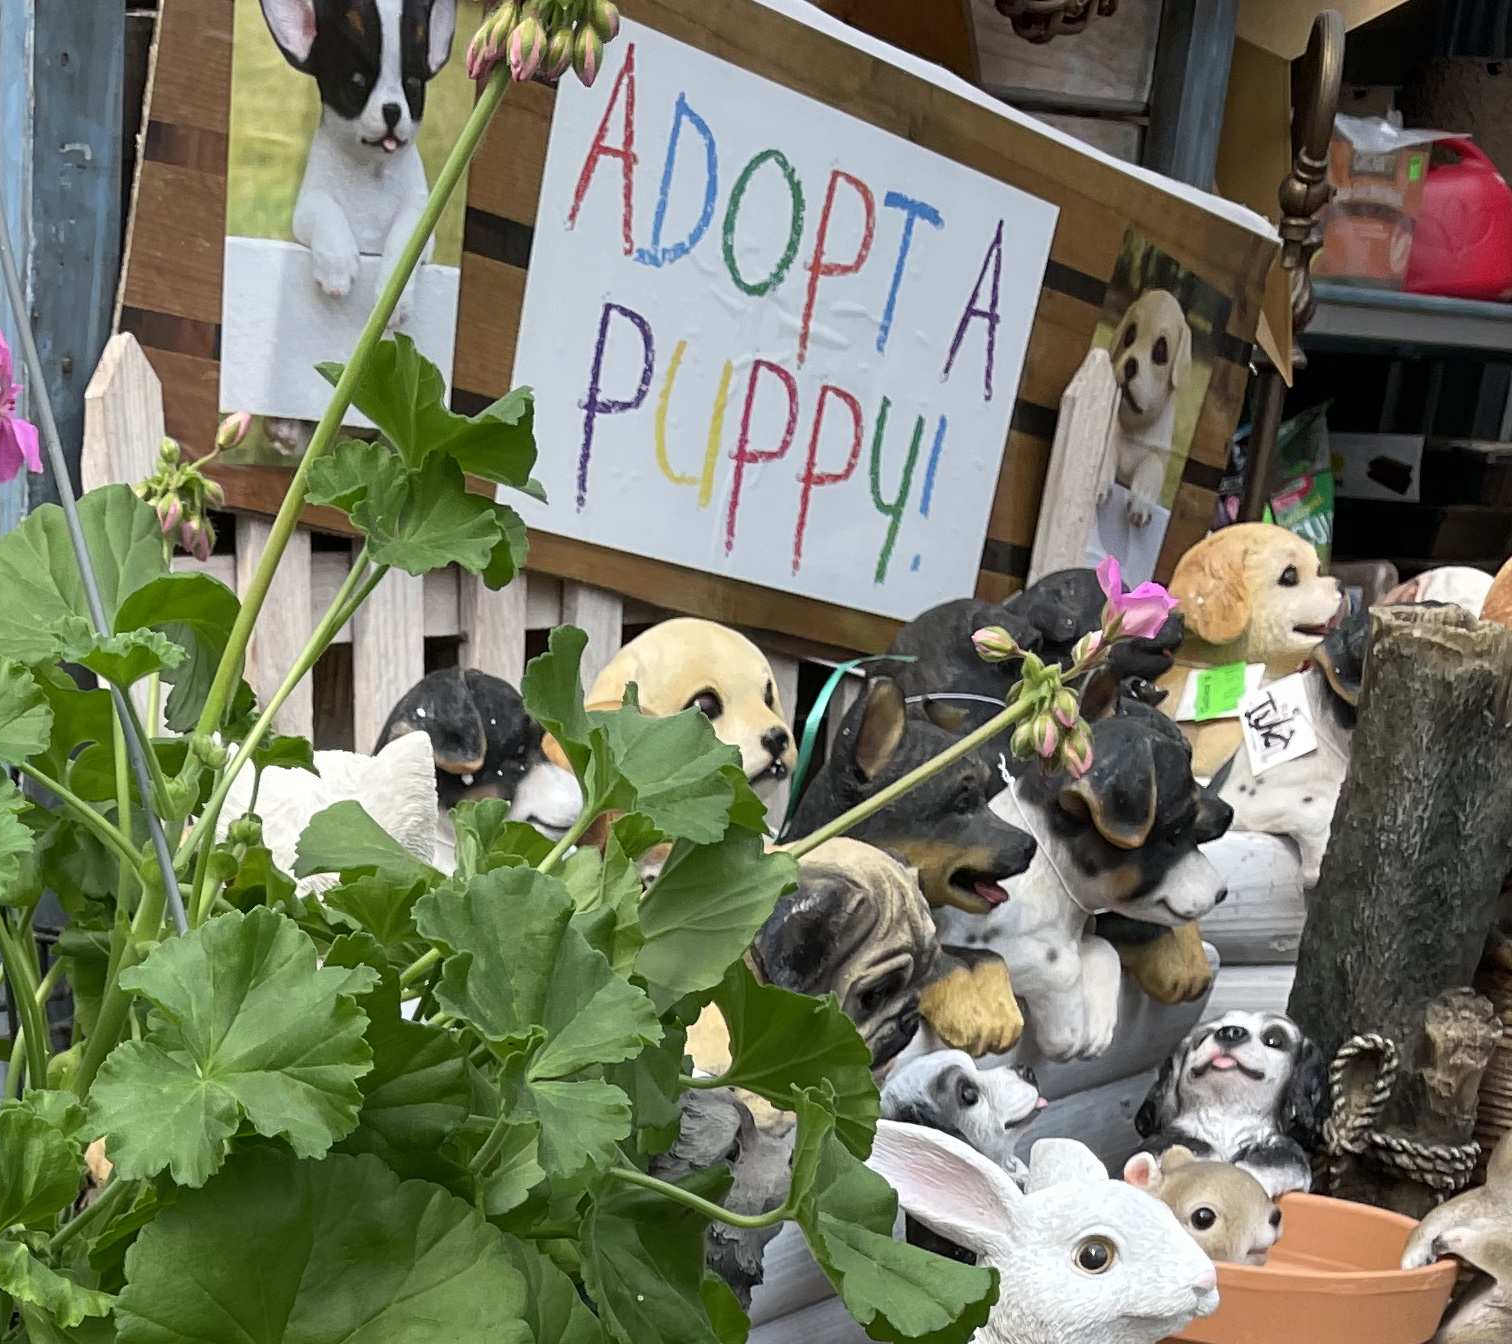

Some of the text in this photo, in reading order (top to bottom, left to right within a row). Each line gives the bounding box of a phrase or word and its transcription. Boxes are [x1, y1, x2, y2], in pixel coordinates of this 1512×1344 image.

[565, 43, 1002, 401] ADOPT A
[577, 292, 948, 583] PUPPY!
